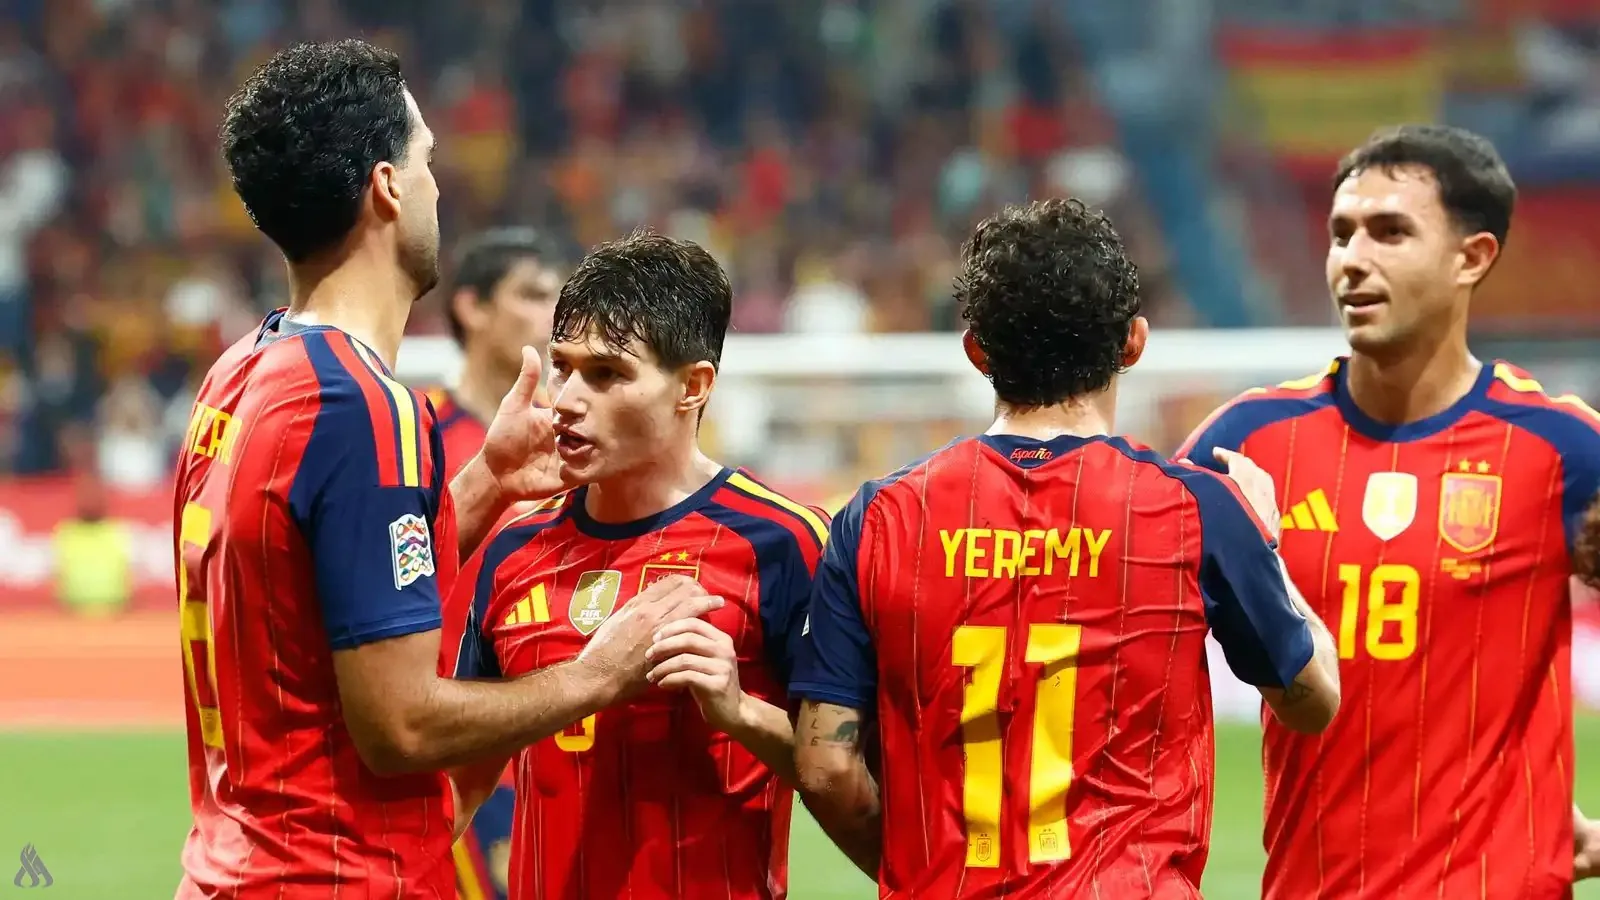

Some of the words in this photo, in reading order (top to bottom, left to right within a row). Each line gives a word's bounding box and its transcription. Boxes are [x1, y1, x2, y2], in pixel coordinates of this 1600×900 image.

[1010, 447, 1053, 464] España
[939, 527, 1113, 579] YEREMY
[1338, 564, 1420, 660] 18
[952, 623, 1082, 868] 11
